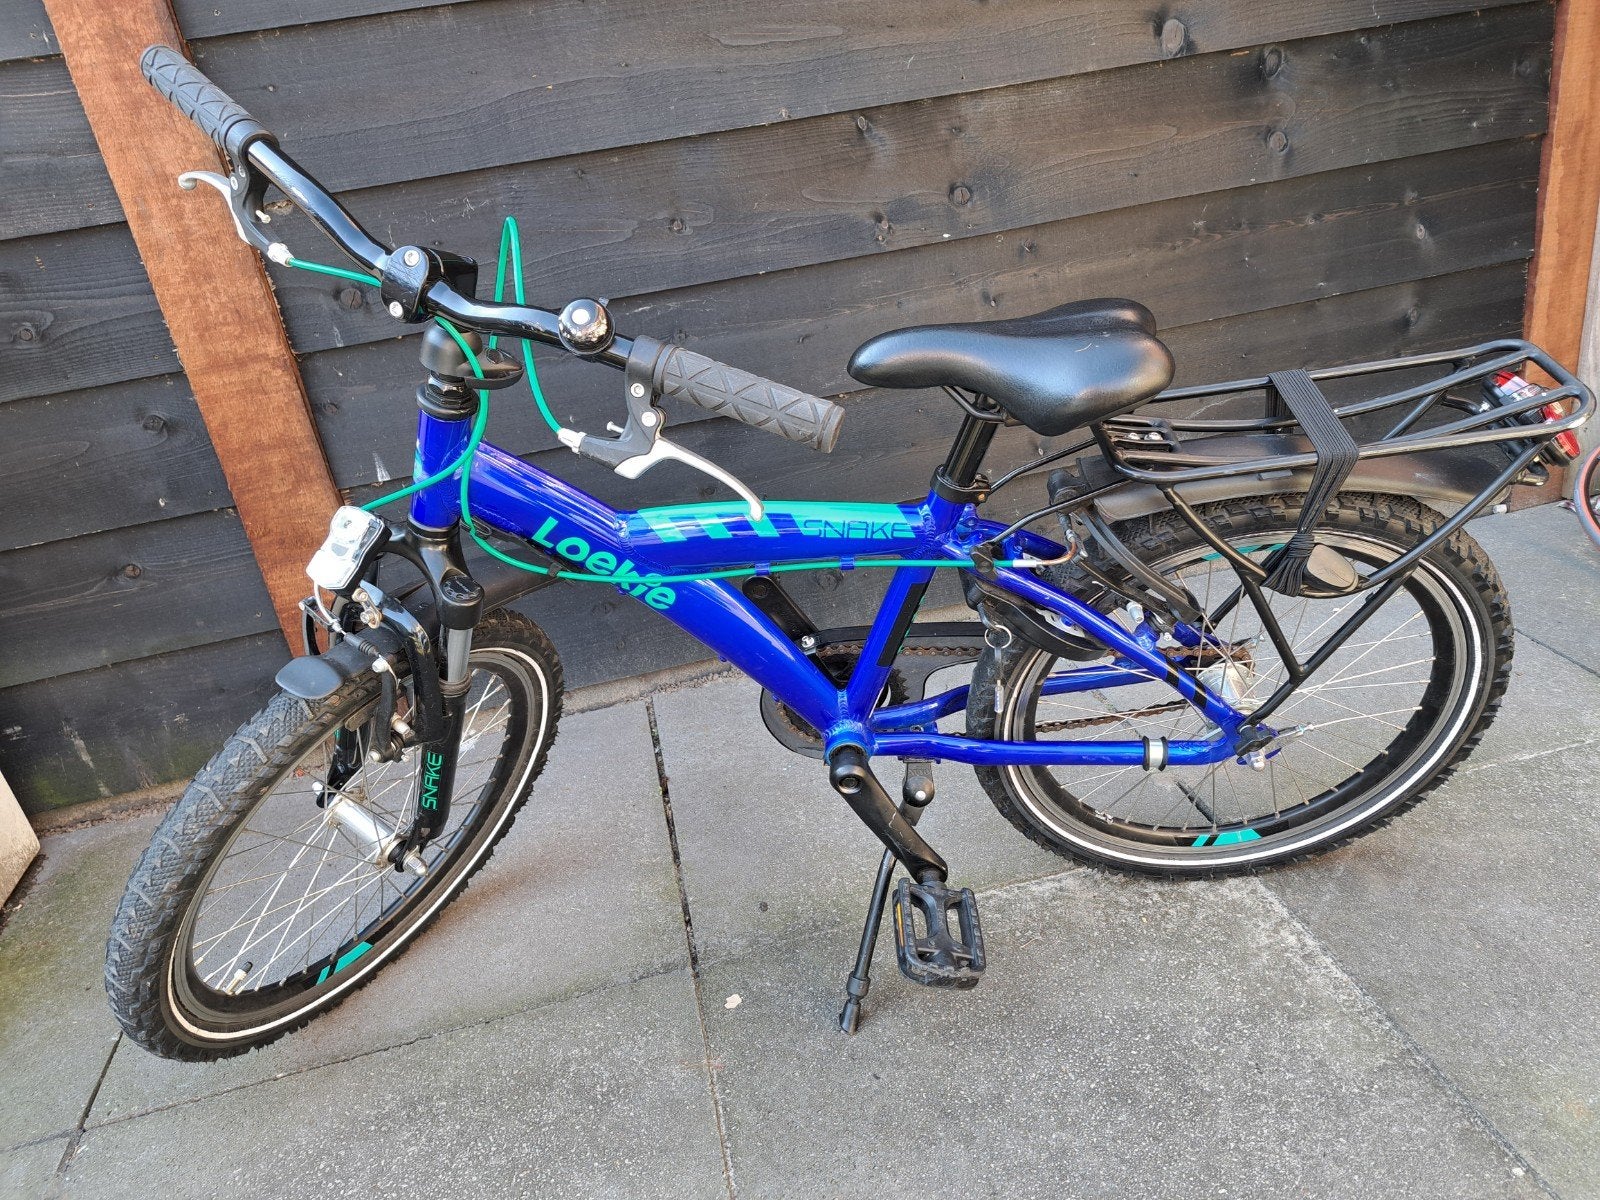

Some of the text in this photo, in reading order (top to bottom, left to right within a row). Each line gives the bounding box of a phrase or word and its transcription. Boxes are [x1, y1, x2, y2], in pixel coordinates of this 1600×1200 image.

[803, 519, 912, 539] SNAKE
[531, 516, 676, 610] Loekie
[422, 751, 443, 810] SNAKE
